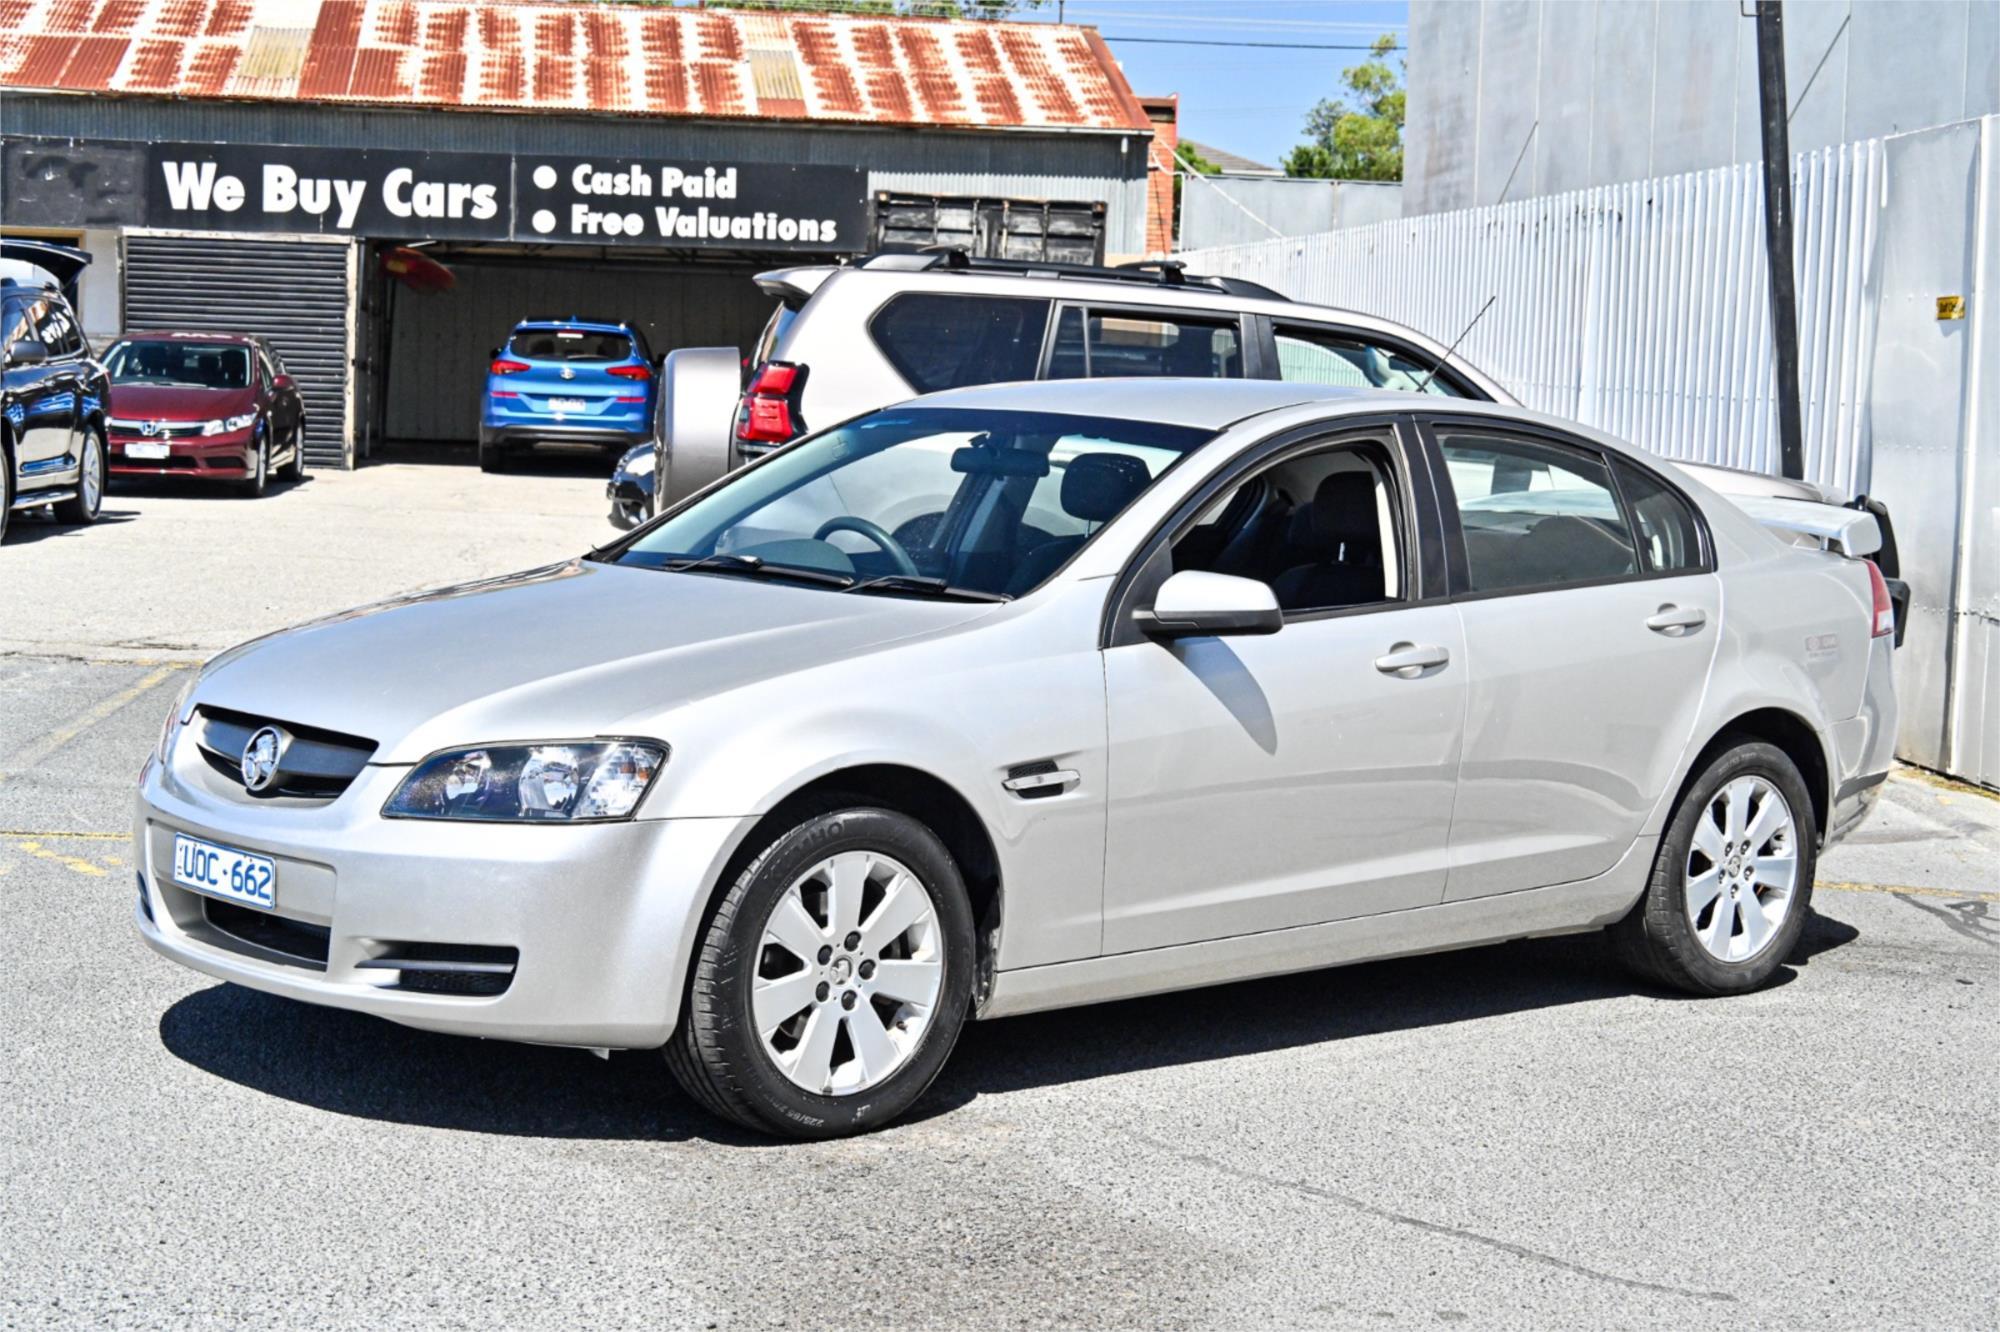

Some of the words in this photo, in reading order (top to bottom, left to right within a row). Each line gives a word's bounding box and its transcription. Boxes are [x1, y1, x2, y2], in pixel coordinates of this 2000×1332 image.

[162, 161, 246, 212] We
[262, 164, 367, 229] Buy
[382, 167, 498, 220] Cars
[571, 163, 652, 197] Cash
[661, 166, 737, 199] Paid
[571, 203, 645, 237] Free
[654, 206, 837, 243] Valuations
